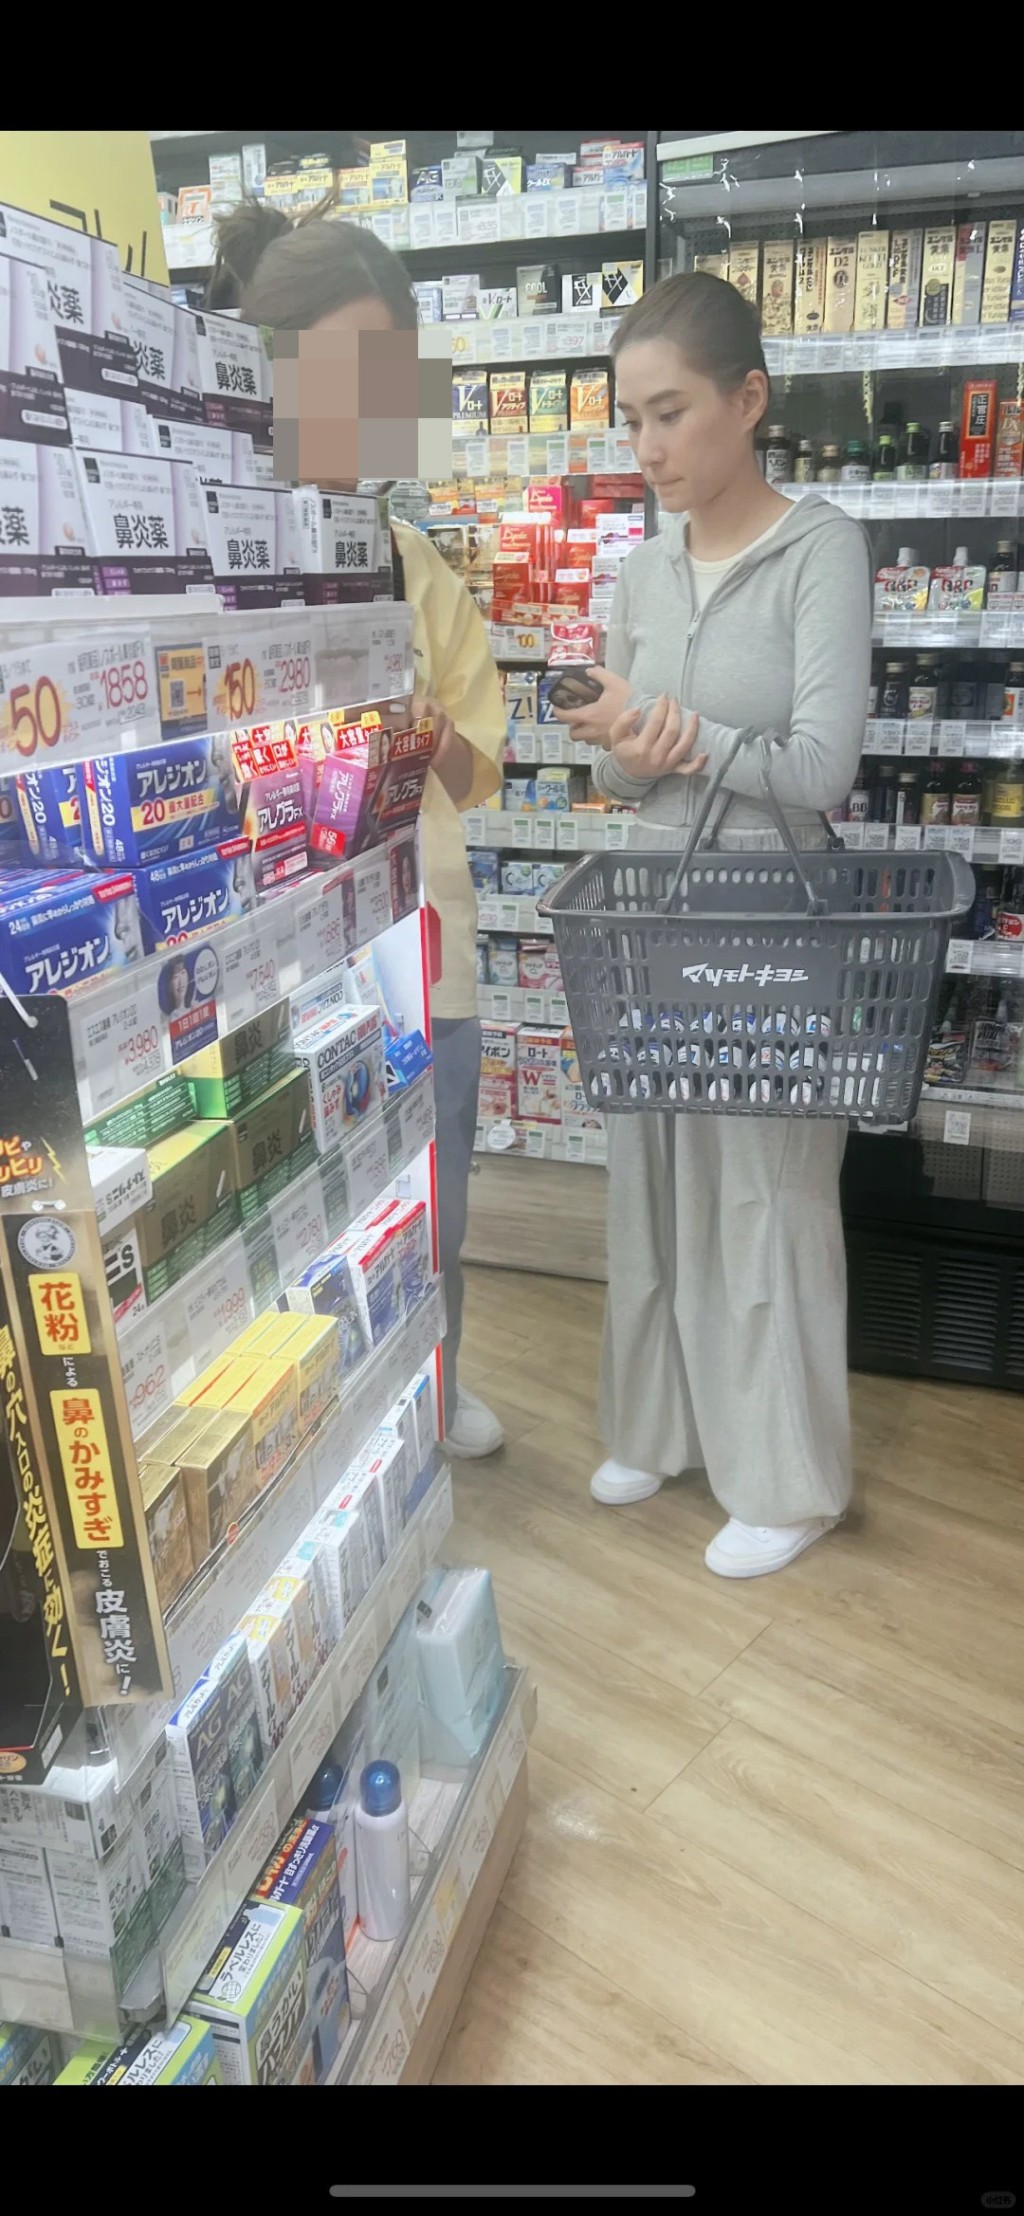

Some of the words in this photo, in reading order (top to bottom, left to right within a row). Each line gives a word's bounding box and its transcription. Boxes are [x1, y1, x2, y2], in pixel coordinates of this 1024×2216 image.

[215, 361, 257, 395] 鼻炎薬
[0, 506, 30, 546] 薬
[113, 513, 169, 549] 鼻炎薬
[227, 538, 270, 569] 鼻炎薬
[335, 541, 368, 568] 鼻炎薬
[137, 759, 208, 797] アレジオン
[140, 797, 165, 826] 20
[161, 887, 229, 934] アレジオン
[25, 935, 110, 994] アレジオン
[682, 962, 809, 987] マツモトキヨシ
[317, 1029, 357, 1068] CONTAC
[528, 1047, 548, 1059] ロート
[521, 1070, 542, 1086] W
[39, 1281, 80, 1342] 花粉
[62, 1397, 113, 1543] 鼻のかみすぎ
[97, 1550, 113, 1588] でおこる
[95, 1590, 137, 1696] 皮膚炎に!
[220, 1921, 261, 1982] ラベルレスに
